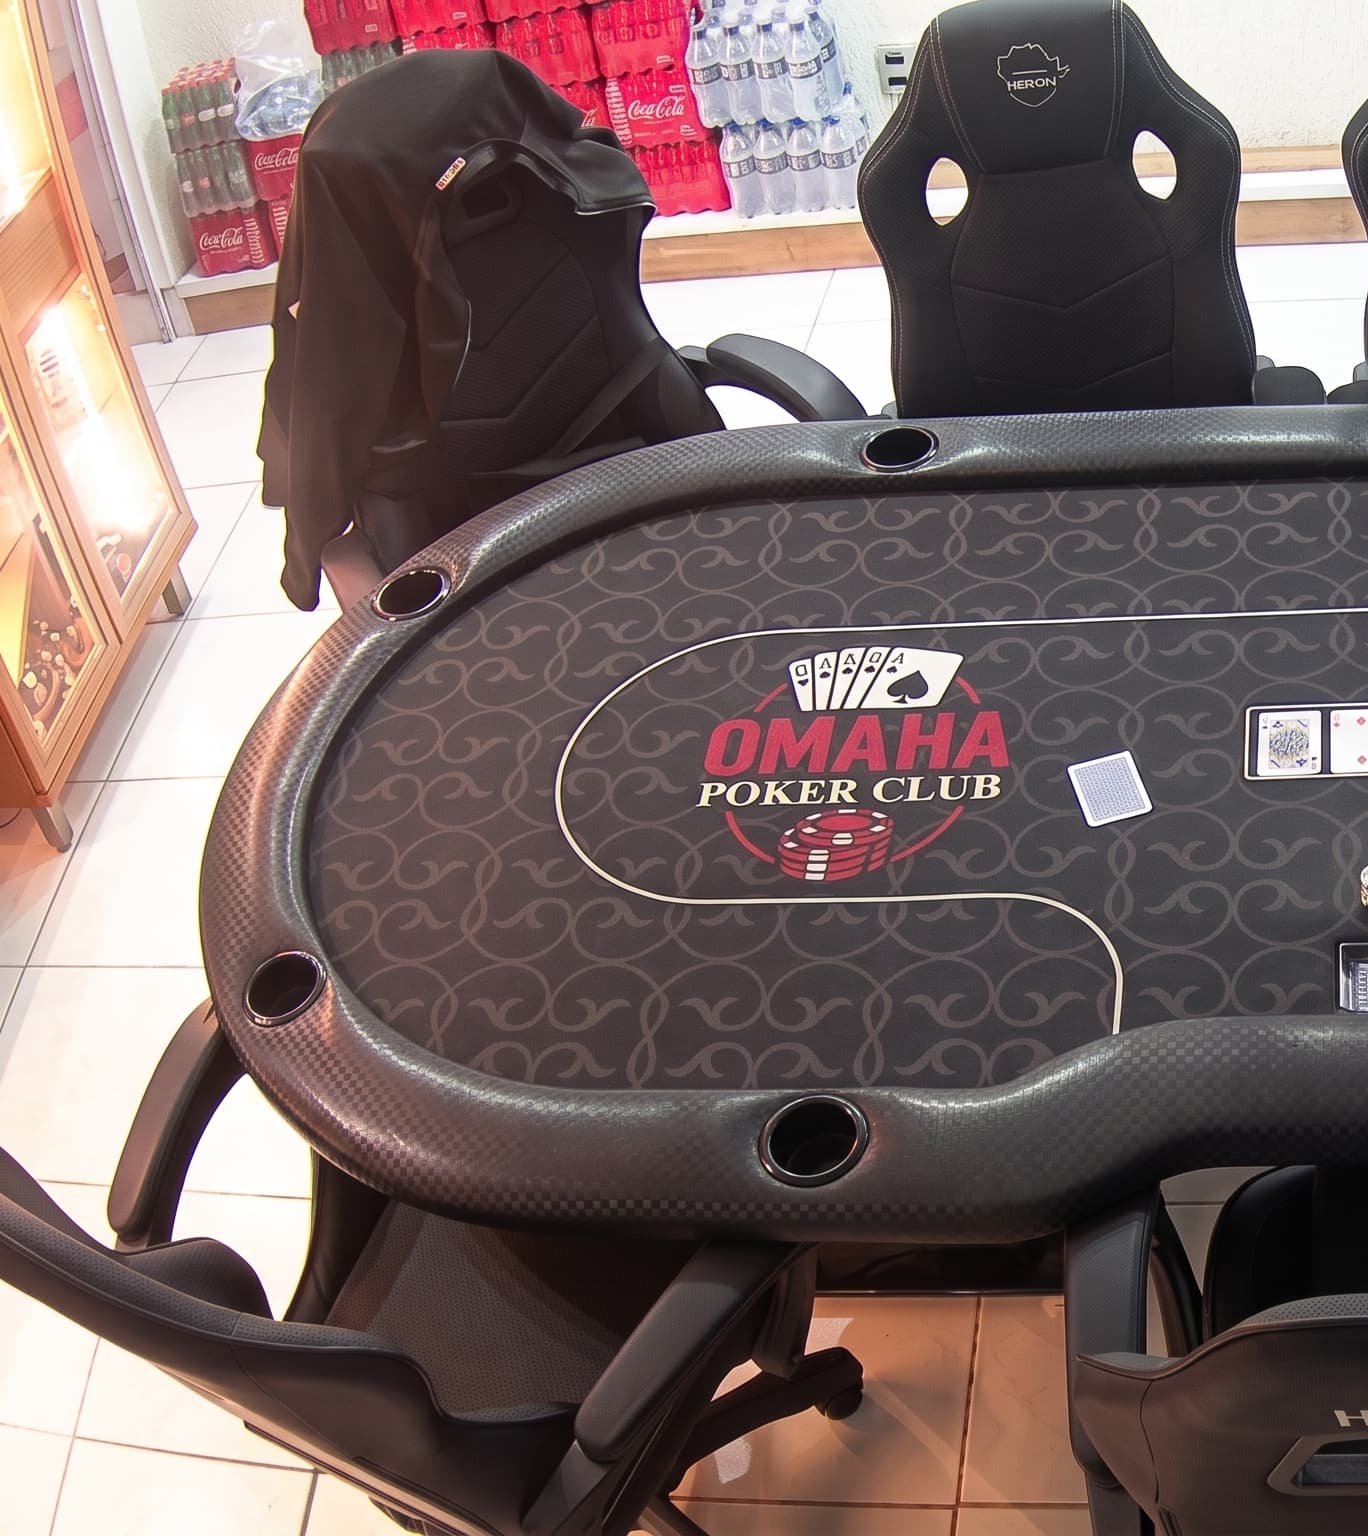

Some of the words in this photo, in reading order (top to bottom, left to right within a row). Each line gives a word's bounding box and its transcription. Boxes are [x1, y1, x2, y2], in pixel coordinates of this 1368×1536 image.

[1006, 75, 1057, 92] HERON
[891, 652, 904, 664] A
[704, 710, 1011, 777] OMAHA
[696, 776, 864, 808] POKER
[872, 773, 1002, 804] CLUB
